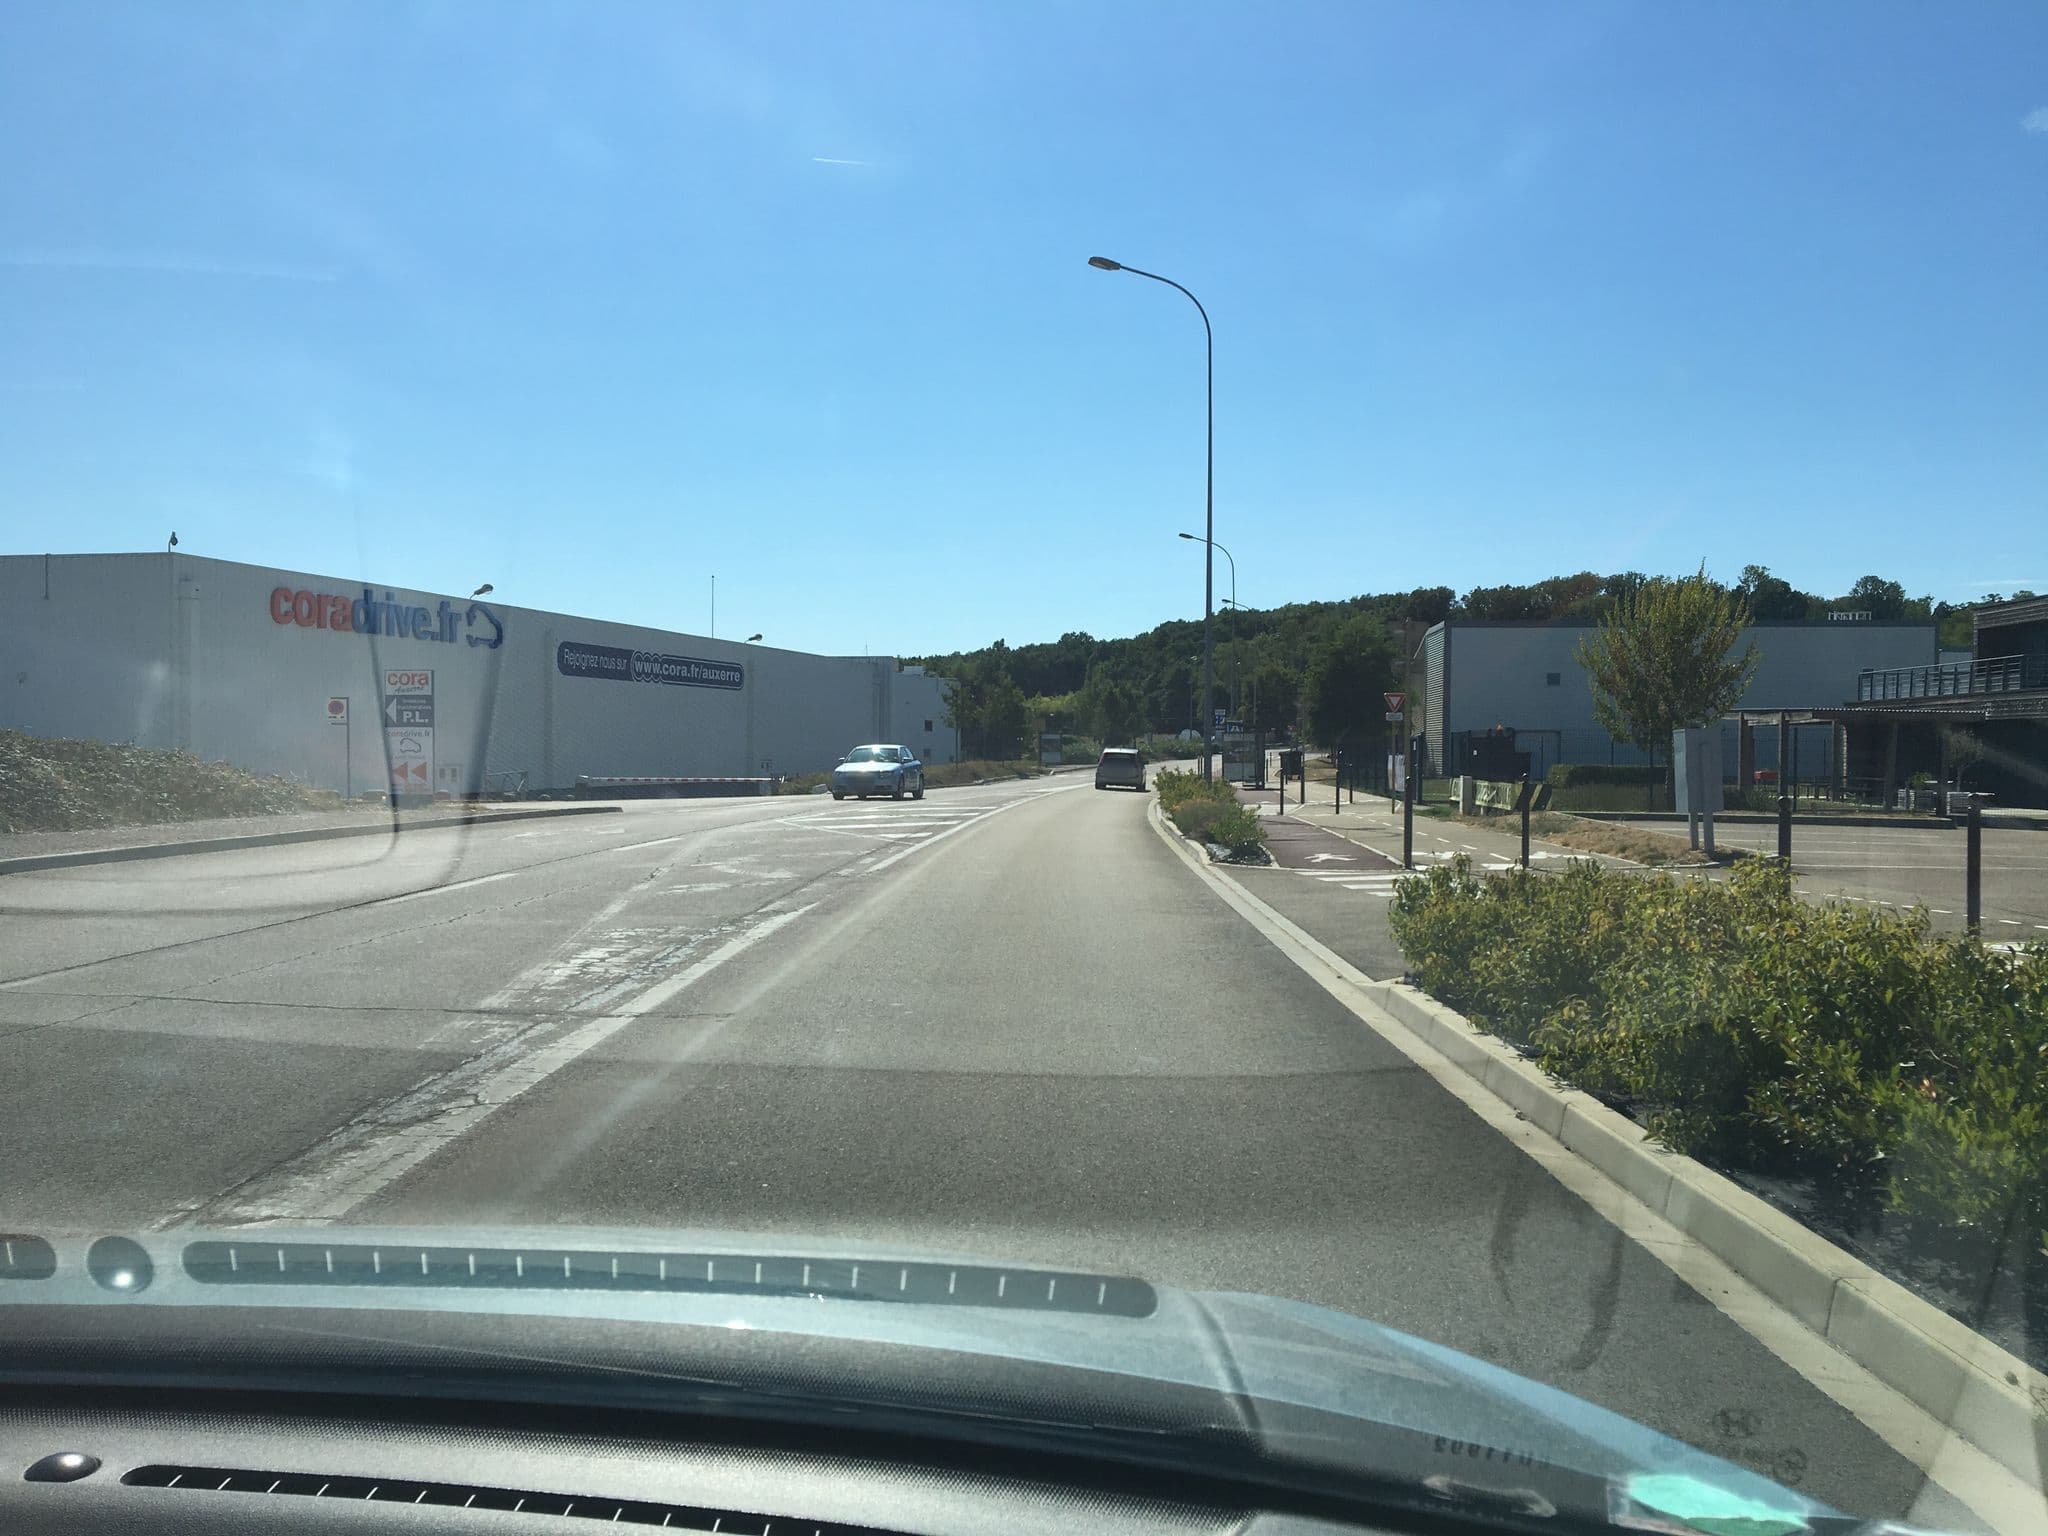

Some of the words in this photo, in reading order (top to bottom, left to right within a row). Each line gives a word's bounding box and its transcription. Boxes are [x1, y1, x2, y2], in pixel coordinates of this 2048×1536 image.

[270, 587, 462, 643] coradrive.fr
[564, 648, 598, 670] Rejoignez
[600, 656, 615, 669] nous
[616, 658, 628, 670] sur
[634, 659, 741, 682] www.cora.fr/auxerre
[387, 672, 429, 686] cora
[403, 711, 429, 723] P.L.
